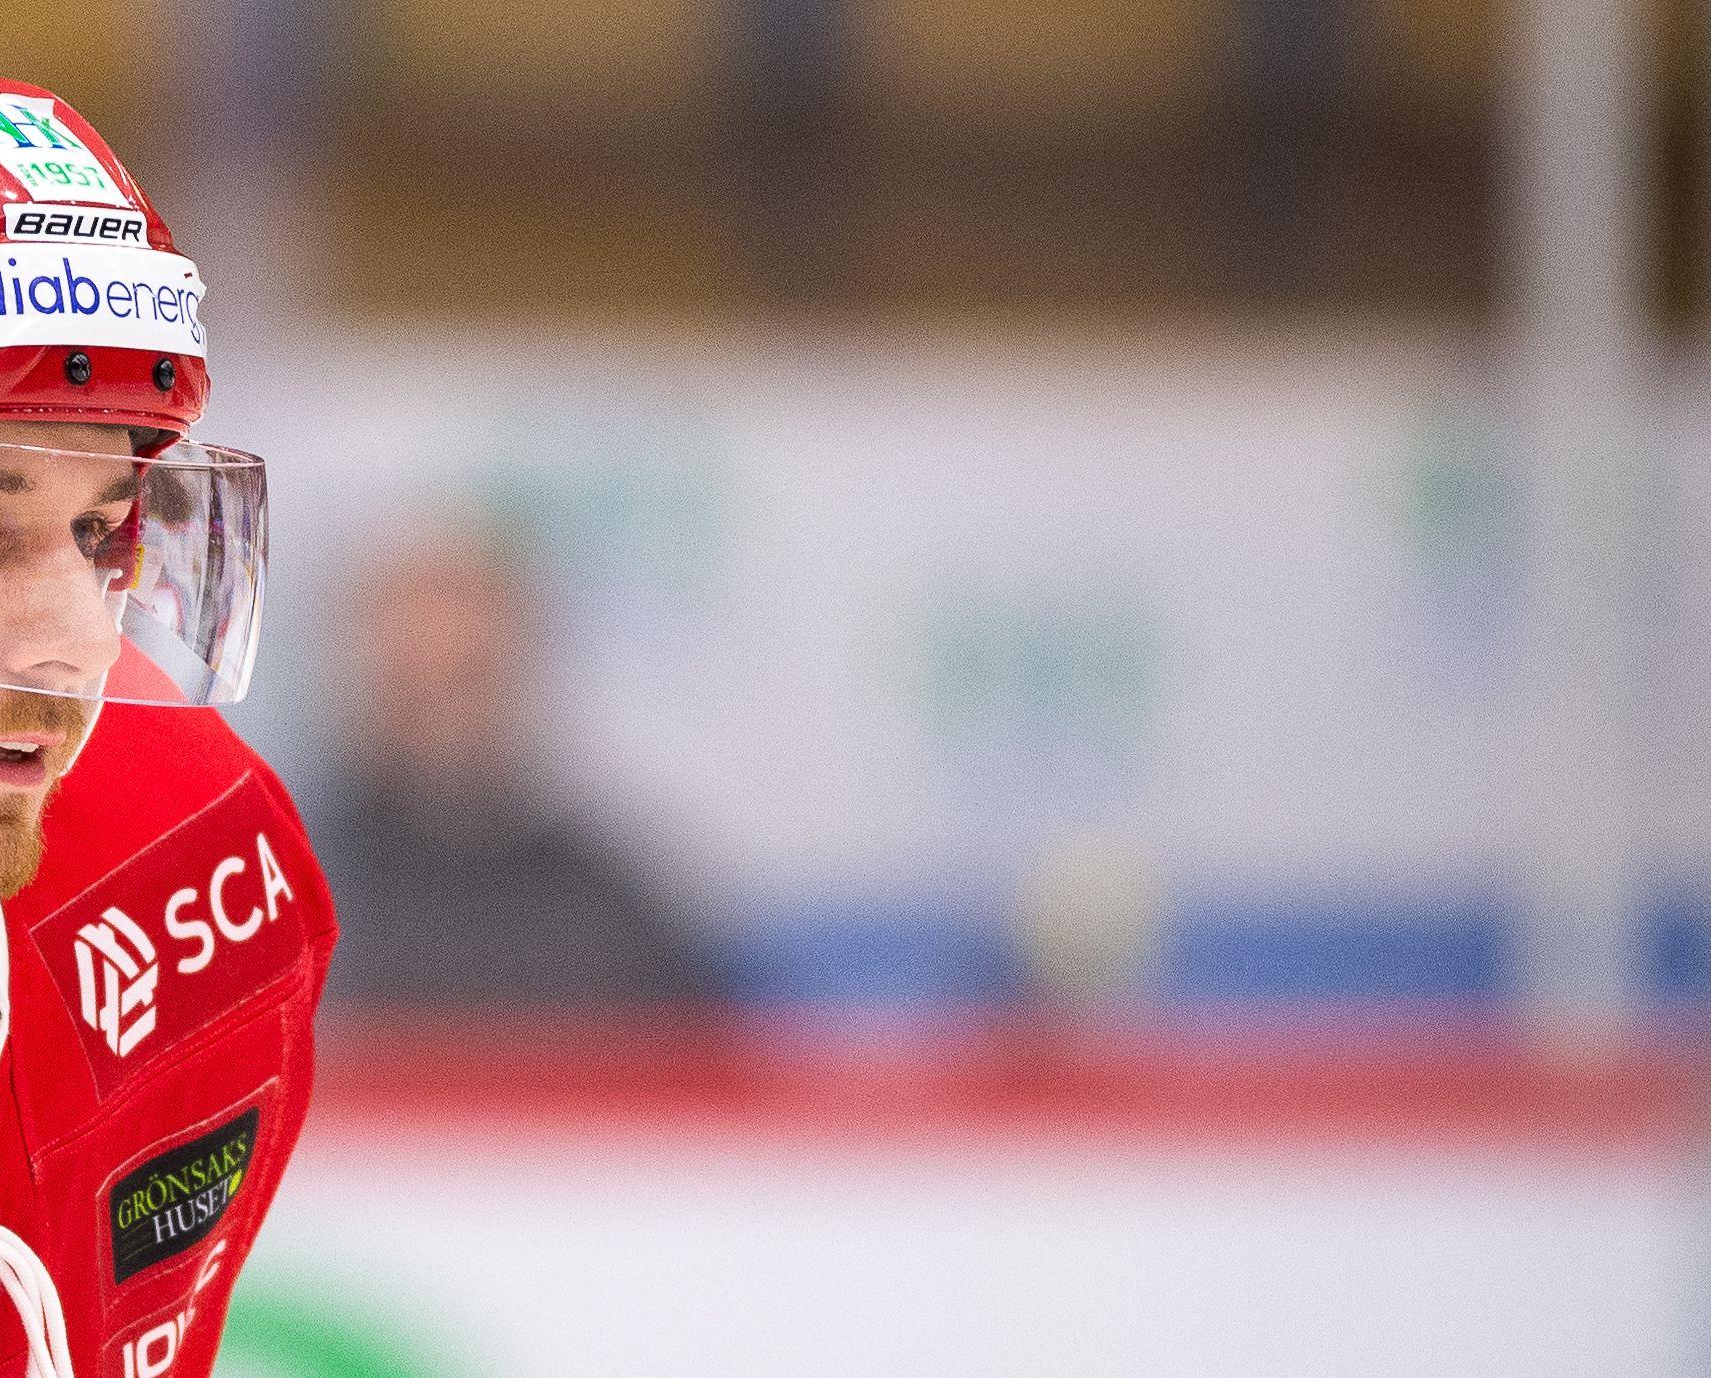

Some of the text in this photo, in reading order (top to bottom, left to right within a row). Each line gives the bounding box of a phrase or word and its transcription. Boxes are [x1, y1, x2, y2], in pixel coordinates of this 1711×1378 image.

[29, 161, 106, 189] 1957
[164, 832, 295, 975] SCA
[117, 1131, 248, 1230] GRÖNSAKS
